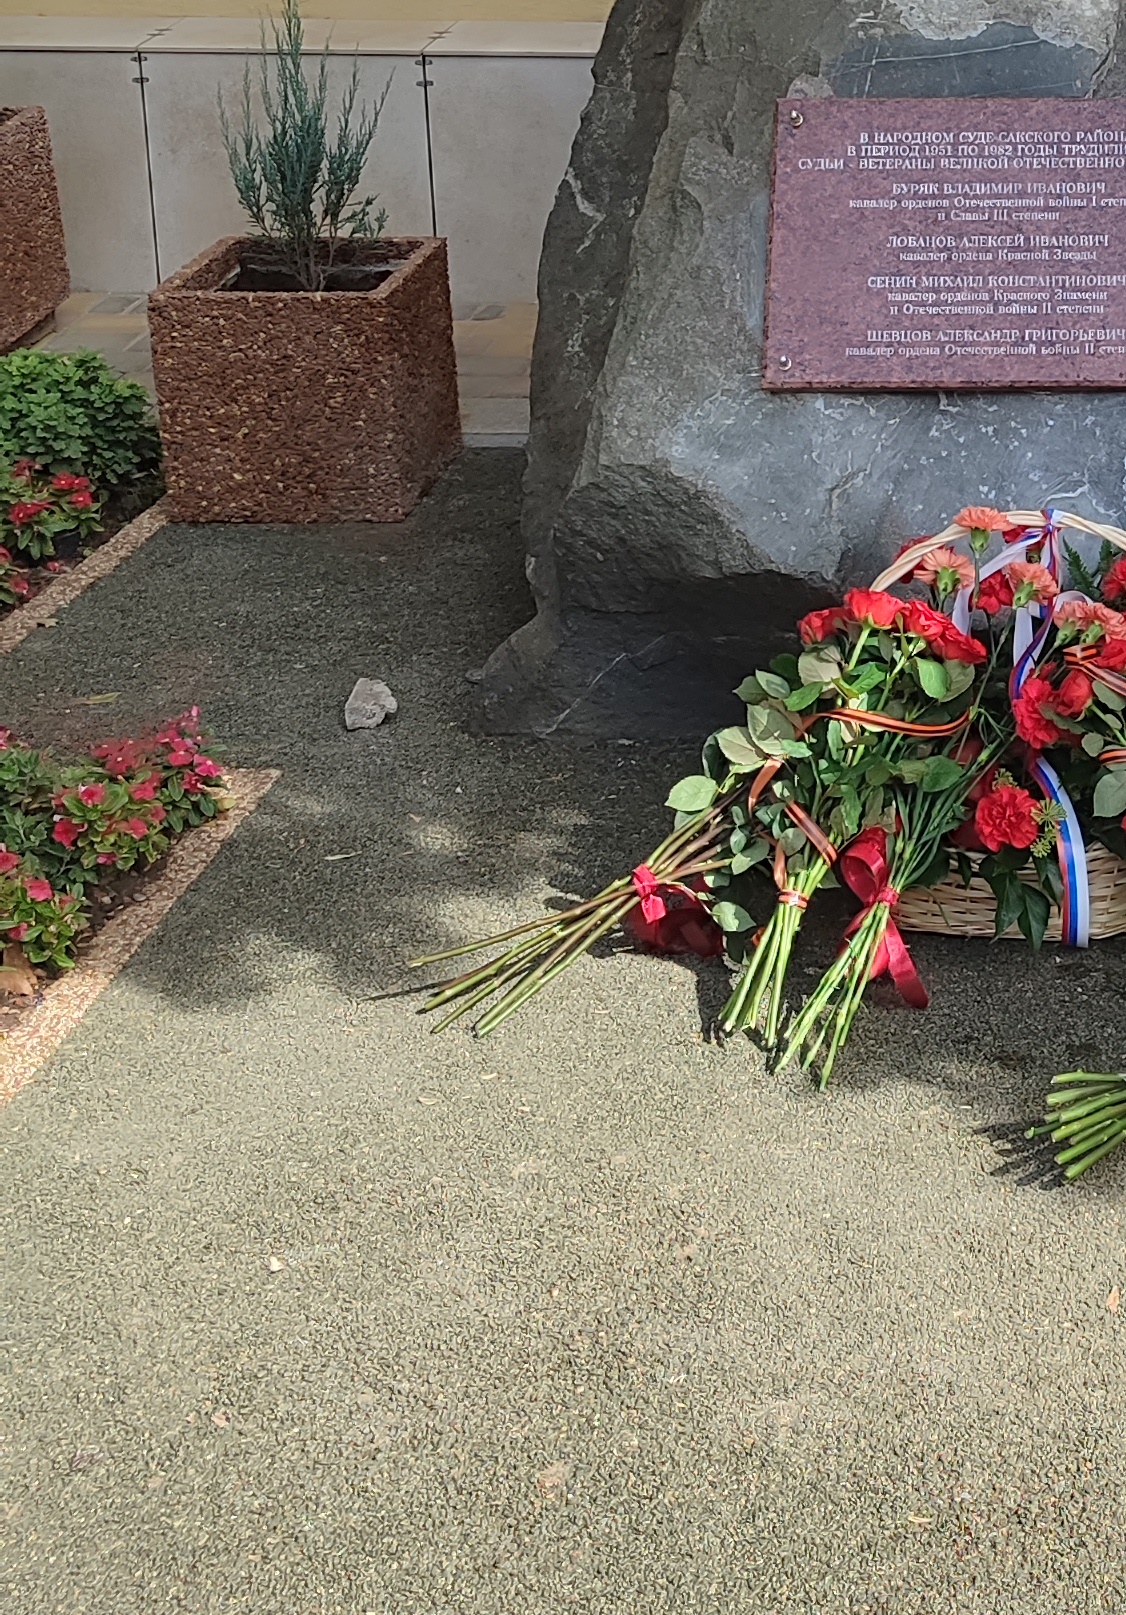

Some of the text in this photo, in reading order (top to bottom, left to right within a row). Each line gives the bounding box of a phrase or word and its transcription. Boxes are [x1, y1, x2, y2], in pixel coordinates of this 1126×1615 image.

[860, 133, 869, 143] В
[874, 132, 954, 144] НАРОДНОМ
[959, 132, 994, 144] СУДЕ
[999, 131, 1071, 143] САКСКОГО
[847, 146, 856, 156] В
[861, 145, 920, 157] ПЕРИОД
[925, 145, 952, 156] 1951
[958, 145, 979, 156] ПО
[984, 145, 1013, 156] 1982
[1017, 145, 1057, 157] ГОДЫ
[798, 158, 844, 170] СУДЬИ
[859, 158, 934, 169] ВЕТЕРАНЫ
[940, 156, 1009, 169] ВЕЛИКОЙ
[892, 182, 1106, 194] БУРЯК ВЛАДИМИР ИВАНОВИЧ
[849, 199, 897, 209] кавалер
[901, 199, 949, 209] орденов
[954, 196, 1044, 208] Отечественной
[1048, 197, 1087, 207] войны
[1092, 196, 1097, 207] I
[937, 209, 1060, 221] и Славы III степени
[886, 234, 1109, 247] ЛОБАНОВ АЛЕКСЕЙ ИВАНОВИЧ
[900, 248, 1097, 262] кавалер ордена Красной Звезды
[867, 275, 1126, 288] СЕНИН МИХАИЛ КОНСТАНТИНОВИЧ
[888, 289, 1108, 303] кавалер орденов Красного Знамени
[889, 302, 1104, 315] и Отечественной войны II степени
[867, 329, 1126, 342] ШЕВЦОВ АЛЕКСАНДР ГРИГОРЬЕВИЧ
[845, 346, 894, 357] кавалер
[898, 346, 940, 357] ордена
[944, 344, 1036, 355] Отечественной
[1041, 344, 1080, 354] войны
[1085, 343, 1094, 354] II
